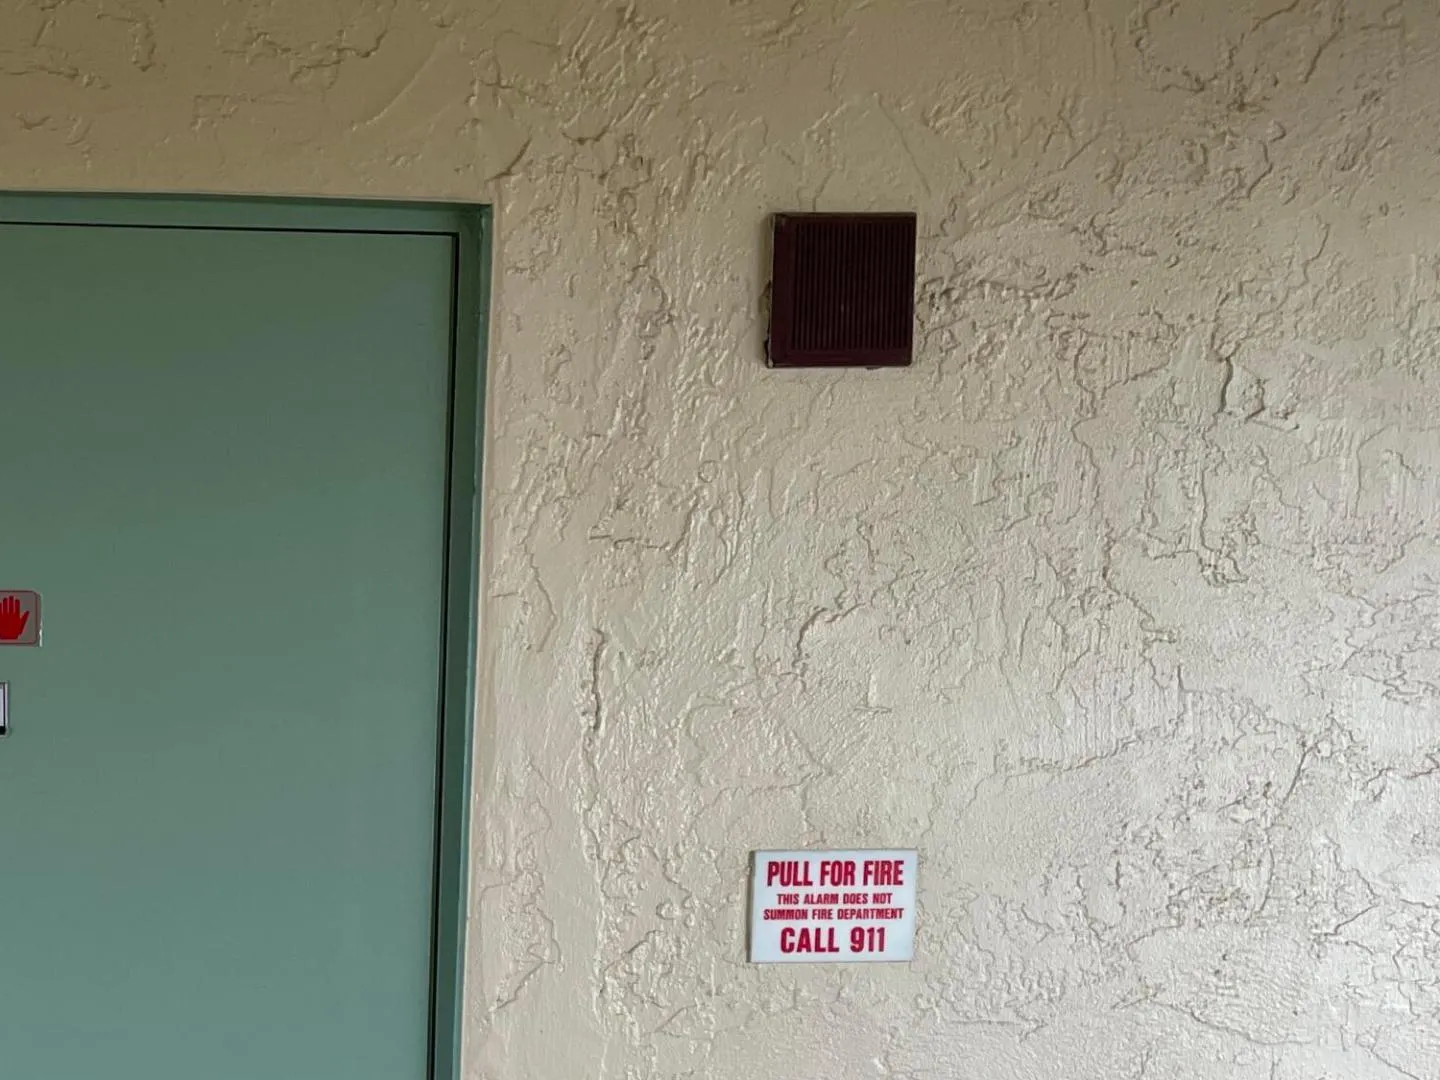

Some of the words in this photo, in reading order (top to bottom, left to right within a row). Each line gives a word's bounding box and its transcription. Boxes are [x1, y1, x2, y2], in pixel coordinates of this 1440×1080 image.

[767, 861, 813, 887] PULL
[820, 860, 856, 886] FOR
[863, 860, 904, 886] FIRE
[776, 894, 800, 905] THIS
[804, 894, 839, 905] ALARM
[842, 893, 868, 905] DOES
[872, 893, 893, 905] NOT
[763, 909, 808, 920] SUMMON
[812, 908, 833, 920] FIRE
[837, 908, 904, 919] DEPARTMENT
[780, 927, 840, 953] CALL
[850, 926, 885, 953] 911
